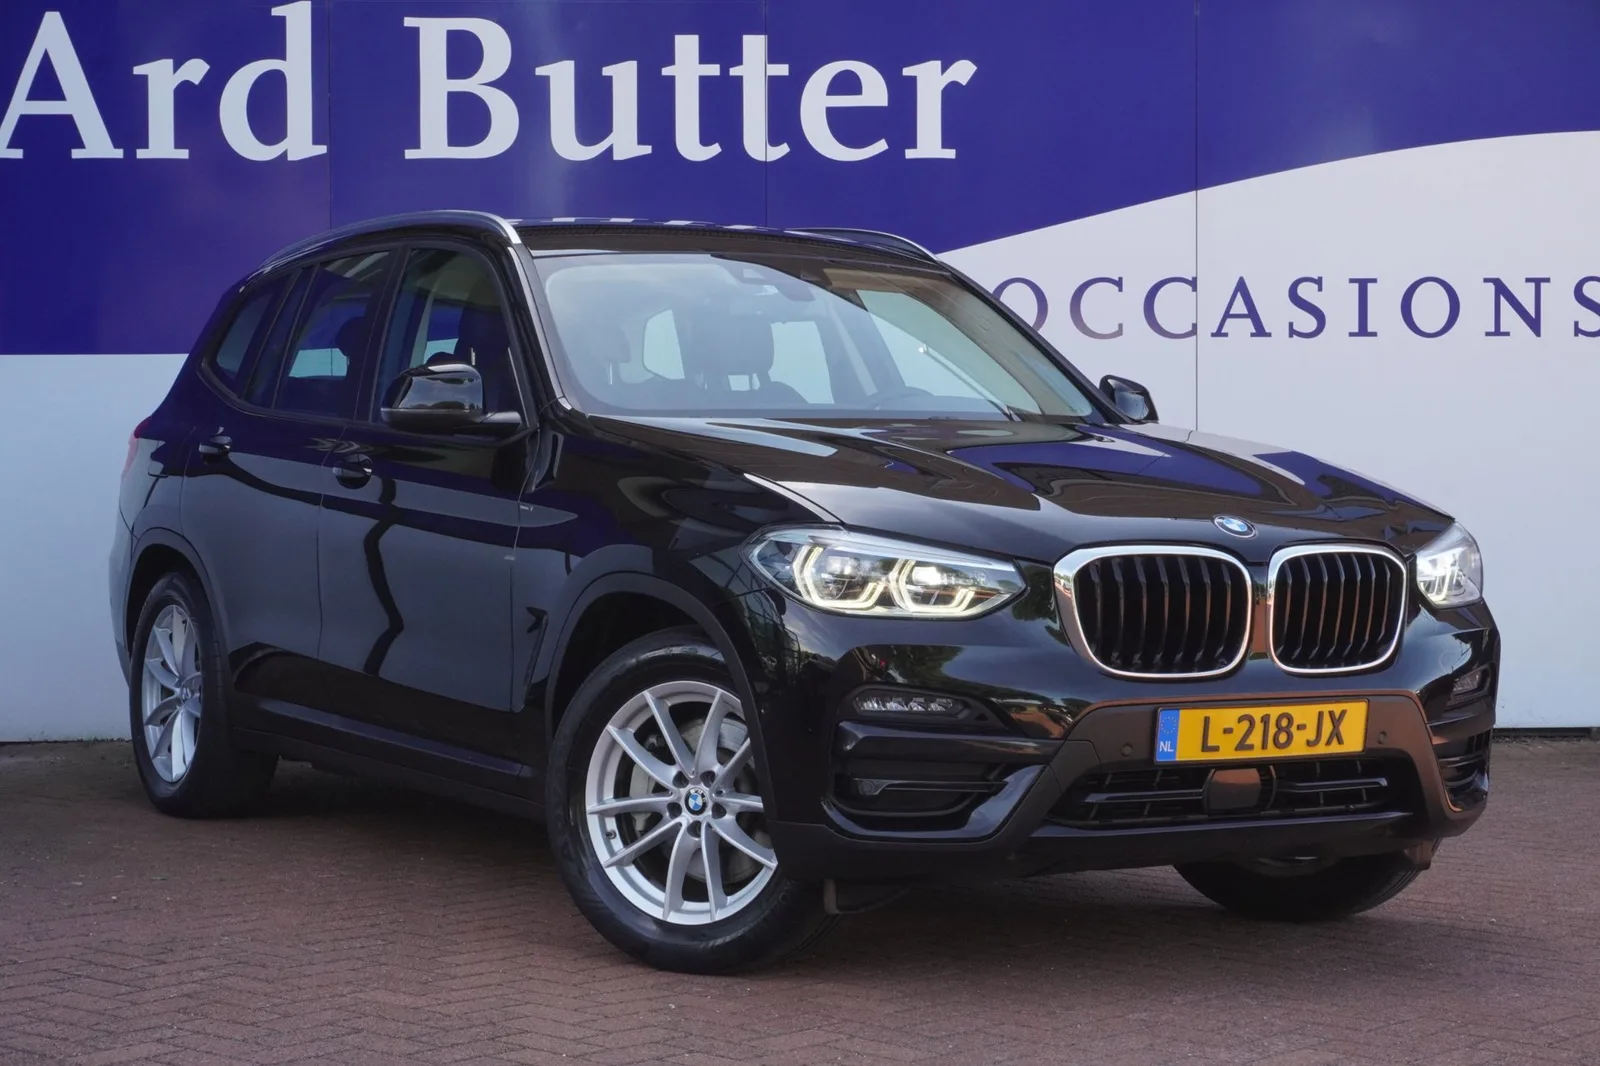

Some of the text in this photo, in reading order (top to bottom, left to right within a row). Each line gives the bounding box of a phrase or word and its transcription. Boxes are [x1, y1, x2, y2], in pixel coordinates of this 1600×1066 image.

[0, 1, 978, 162] Ard Butter
[1160, 740, 1174, 752] NL
[1201, 709, 1347, 752] L-218-JX
